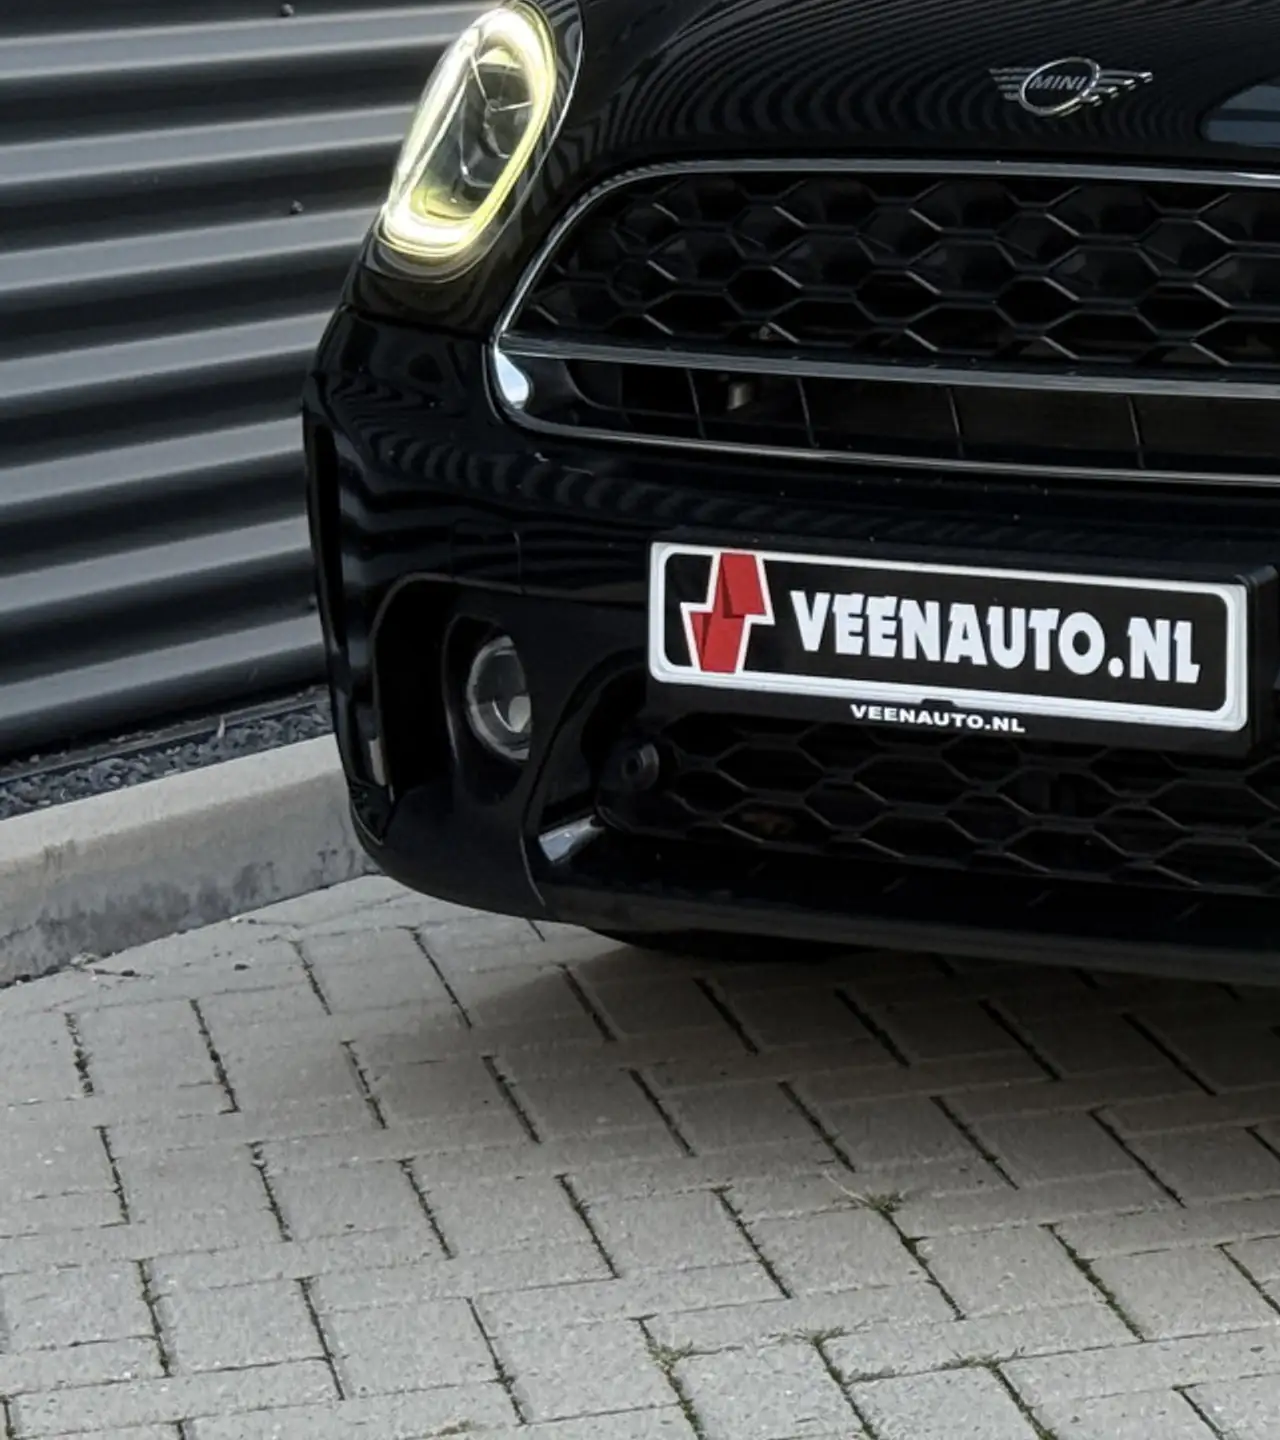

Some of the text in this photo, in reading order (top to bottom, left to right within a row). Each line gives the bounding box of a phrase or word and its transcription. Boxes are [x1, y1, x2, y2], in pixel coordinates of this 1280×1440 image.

[1029, 73, 1088, 92] MINI
[789, 589, 1201, 685] VEENAUTO.NL
[850, 703, 1026, 733] VEENAUTO.NL
